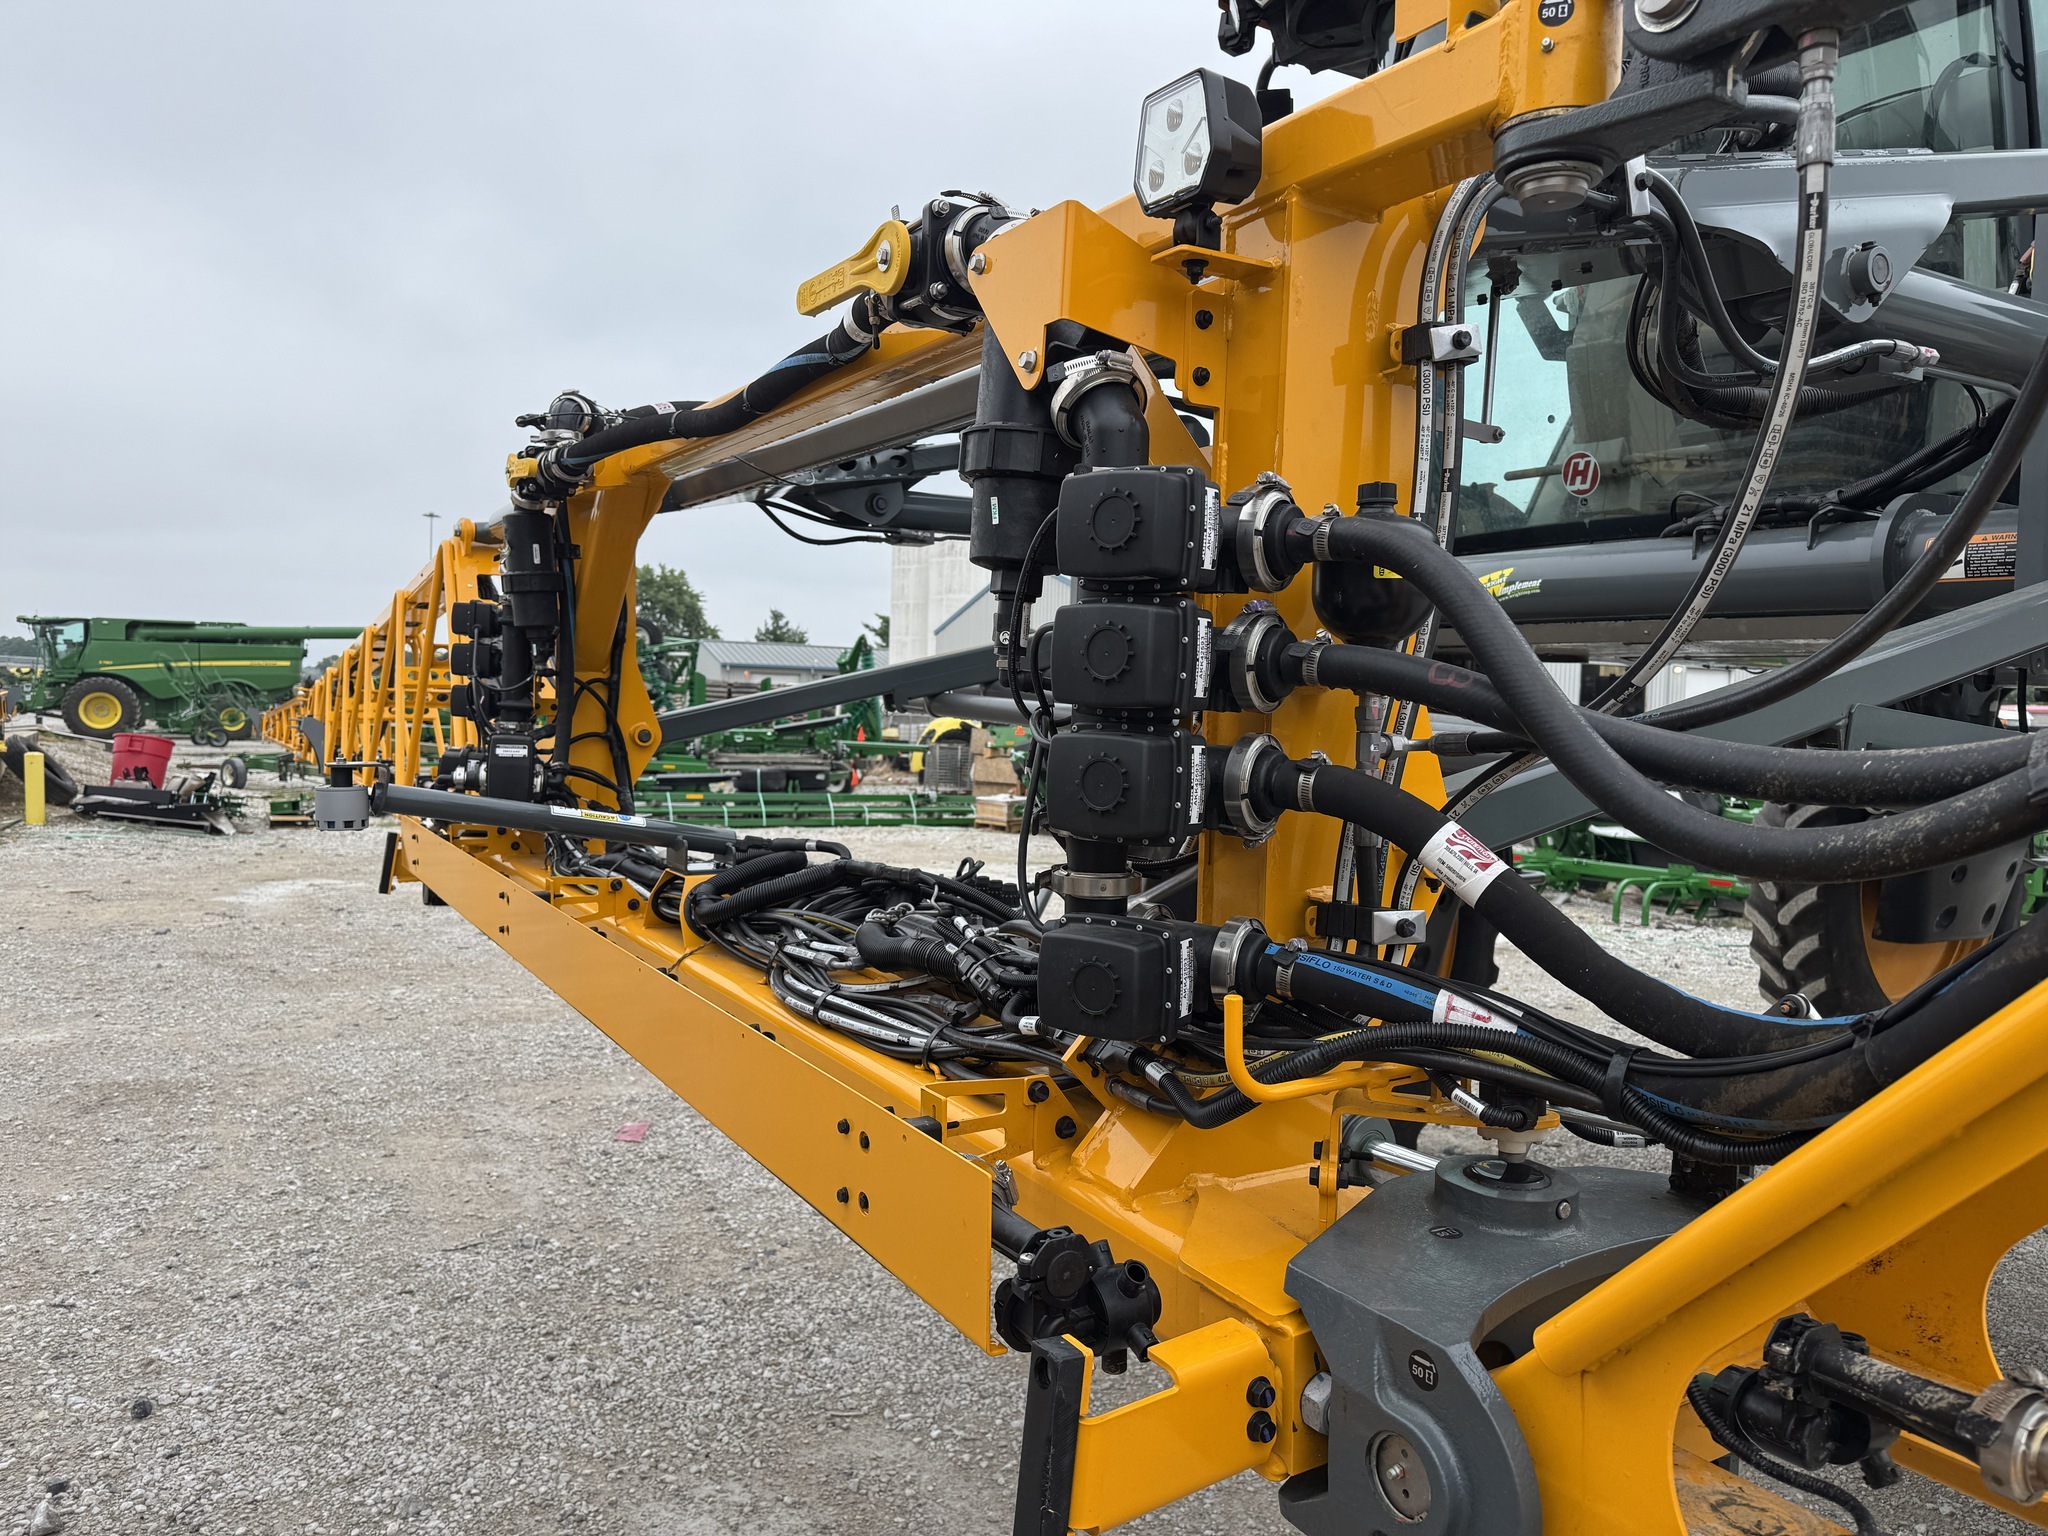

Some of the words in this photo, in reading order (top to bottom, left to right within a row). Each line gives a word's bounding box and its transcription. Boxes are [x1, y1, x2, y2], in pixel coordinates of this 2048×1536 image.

[1542, 7, 1556, 19] 50
[1809, 199, 1820, 229] Parker
[1806, 232, 1815, 272] GLOBALCORE
[1447, 287, 1456, 298] 21
[1801, 281, 1809, 295] ISO
[1447, 300, 1456, 322] MPa
[1801, 319, 1810, 339] 10mm
[1423, 369, 1432, 395] (3000
[1785, 372, 1796, 392] MSHA
[1422, 396, 1431, 417] PSI)
[1740, 504, 1754, 516] 21
[1728, 519, 1747, 545] MPa
[1713, 547, 1735, 576] (3000
[1700, 577, 1719, 599] PSI)
[1333, 964, 1345, 974] 150
[1345, 967, 1372, 983] WATER
[1373, 977, 1380, 985] S
[1379, 979, 1387, 987] &
[1386, 981, 1393, 989] D
[1411, 1363, 1424, 1378] 50
